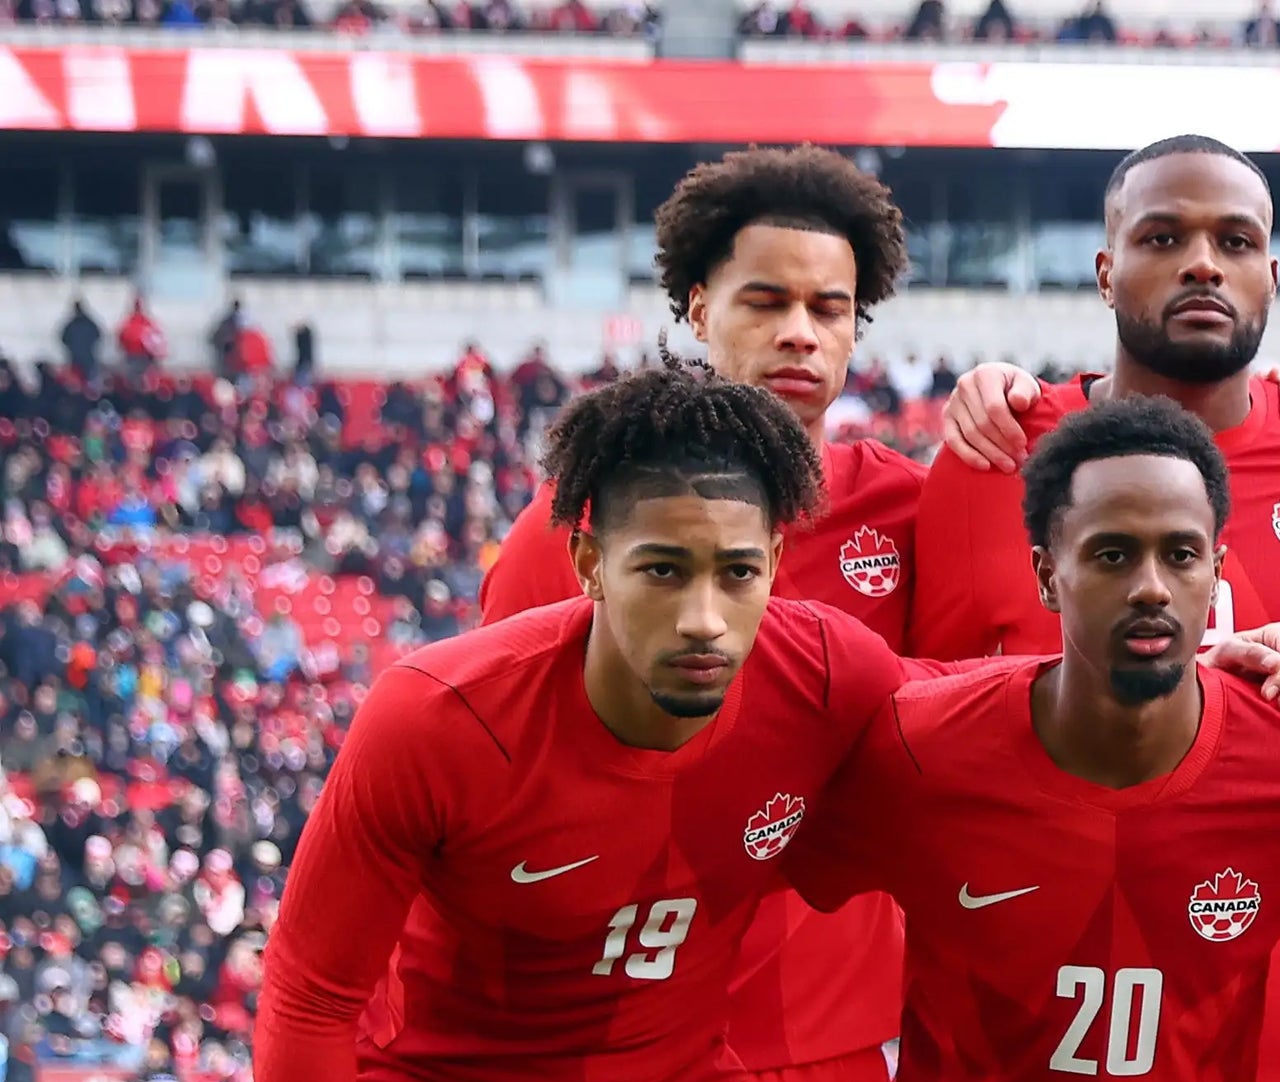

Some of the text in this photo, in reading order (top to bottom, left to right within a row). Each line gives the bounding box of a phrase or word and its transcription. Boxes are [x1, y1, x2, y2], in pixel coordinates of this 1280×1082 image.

[843, 556, 898, 572] CANADA
[745, 812, 803, 843] CANADA
[1190, 900, 1257, 913] CANADA
[592, 897, 697, 980] 19
[1050, 965, 1163, 1076] 20
